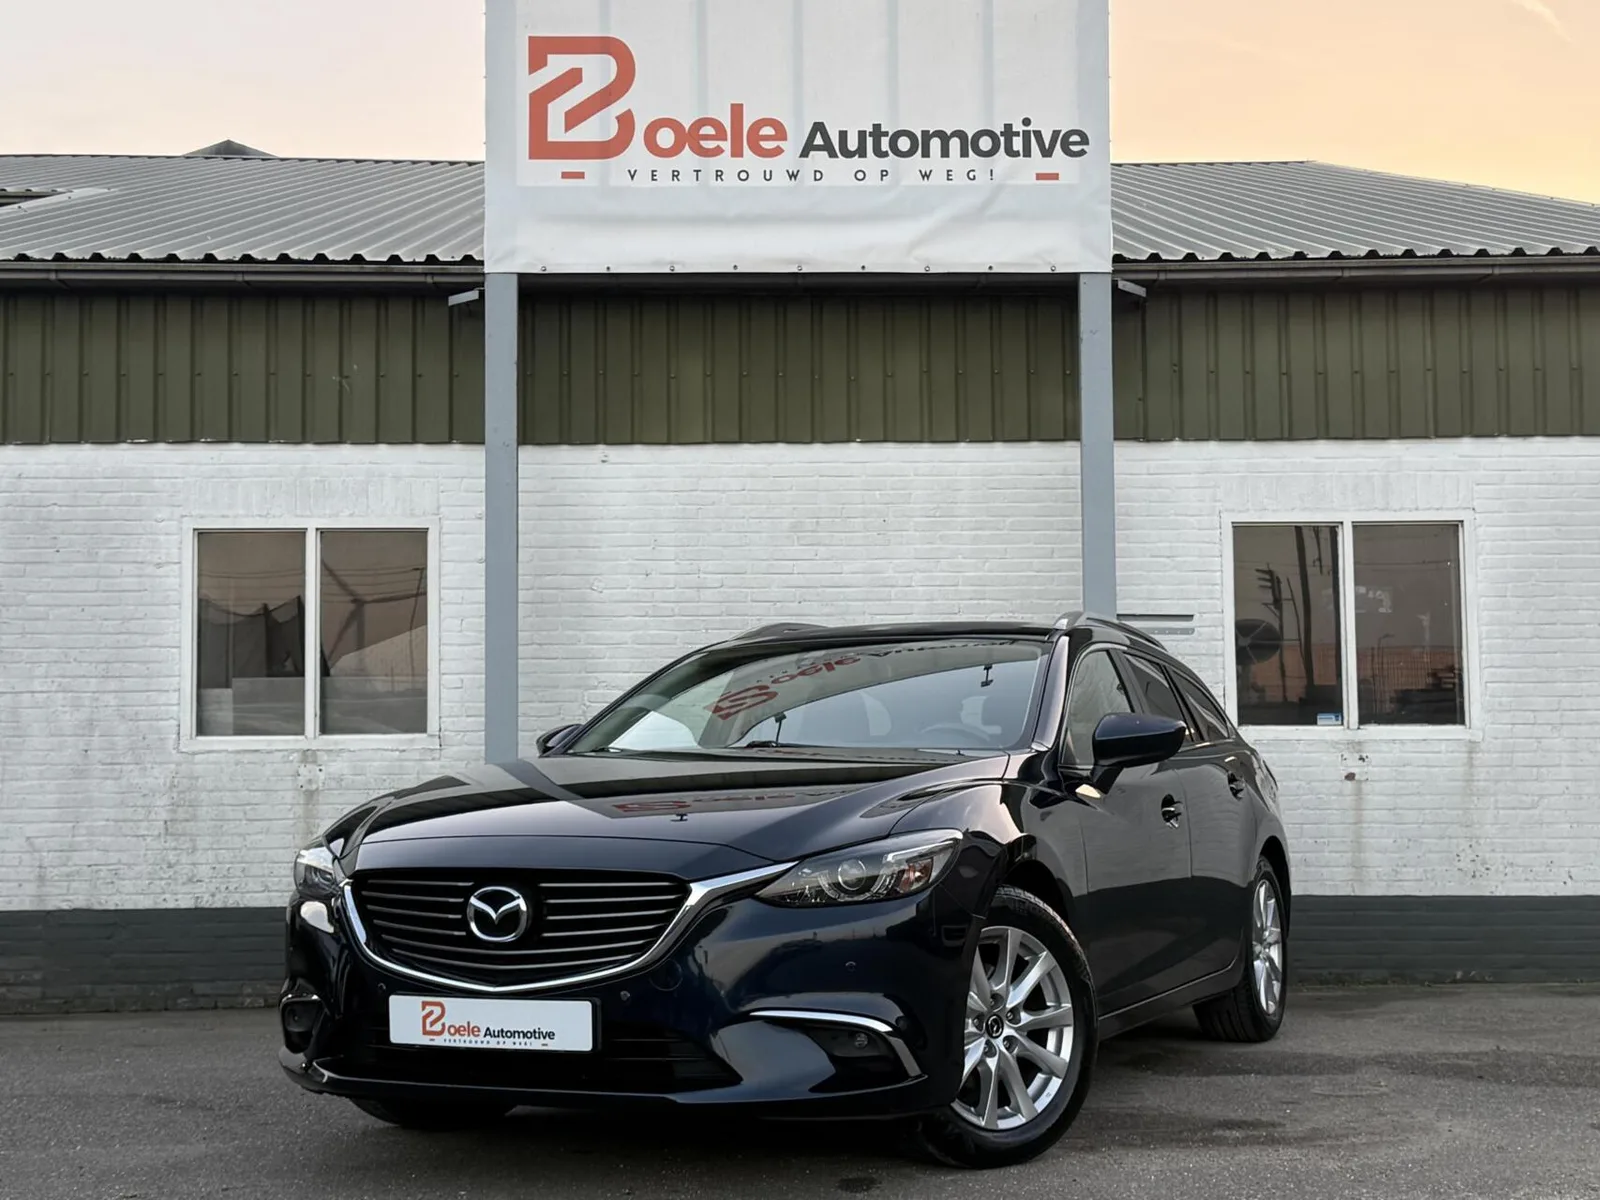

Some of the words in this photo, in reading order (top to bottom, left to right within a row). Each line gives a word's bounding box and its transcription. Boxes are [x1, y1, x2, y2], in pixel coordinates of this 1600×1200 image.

[528, 36, 788, 160] Boele
[799, 117, 1090, 159] Automotive
[627, 169, 823, 182] VERTROUWD
[854, 169, 889, 182] OP
[918, 169, 995, 182] WEG!
[483, 1027, 556, 1040] Automotive
